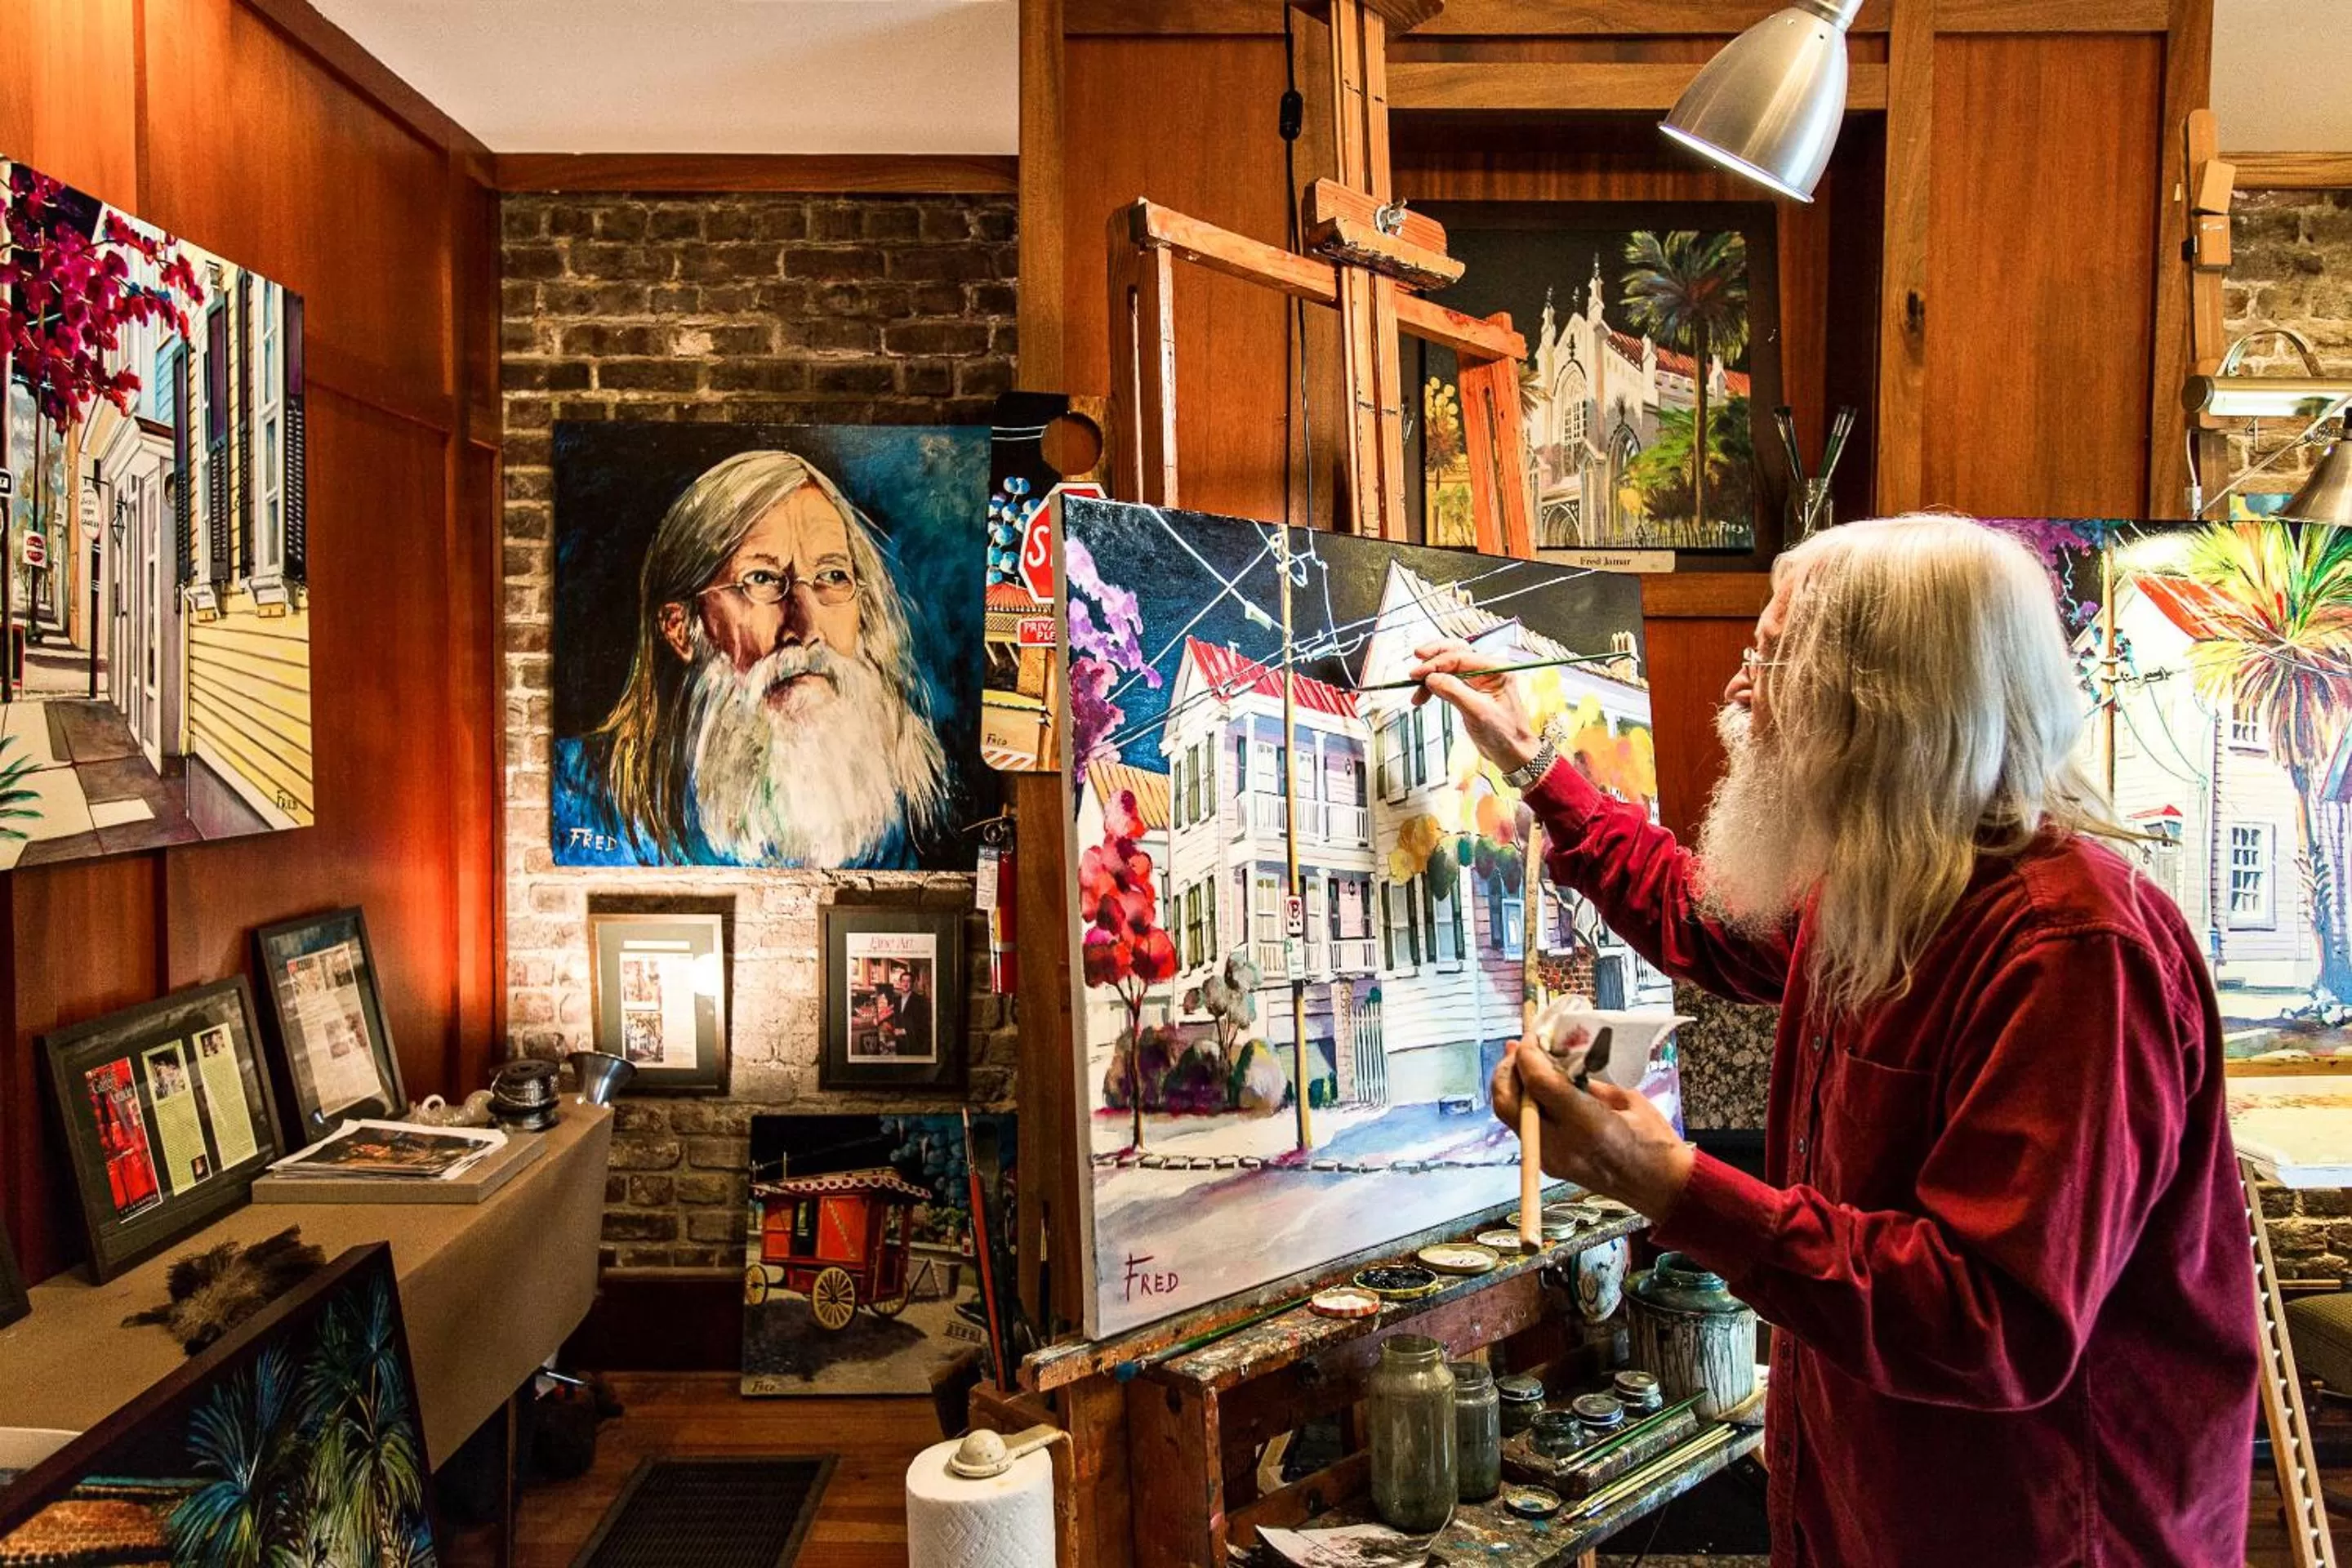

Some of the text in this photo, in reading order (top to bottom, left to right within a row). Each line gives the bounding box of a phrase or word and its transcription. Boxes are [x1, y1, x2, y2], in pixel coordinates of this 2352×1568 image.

[1027, 525, 1054, 568] S
[1580, 556, 1601, 565] Fred
[569, 827, 617, 851] FRED
[1124, 1251, 1178, 1302] FRED
